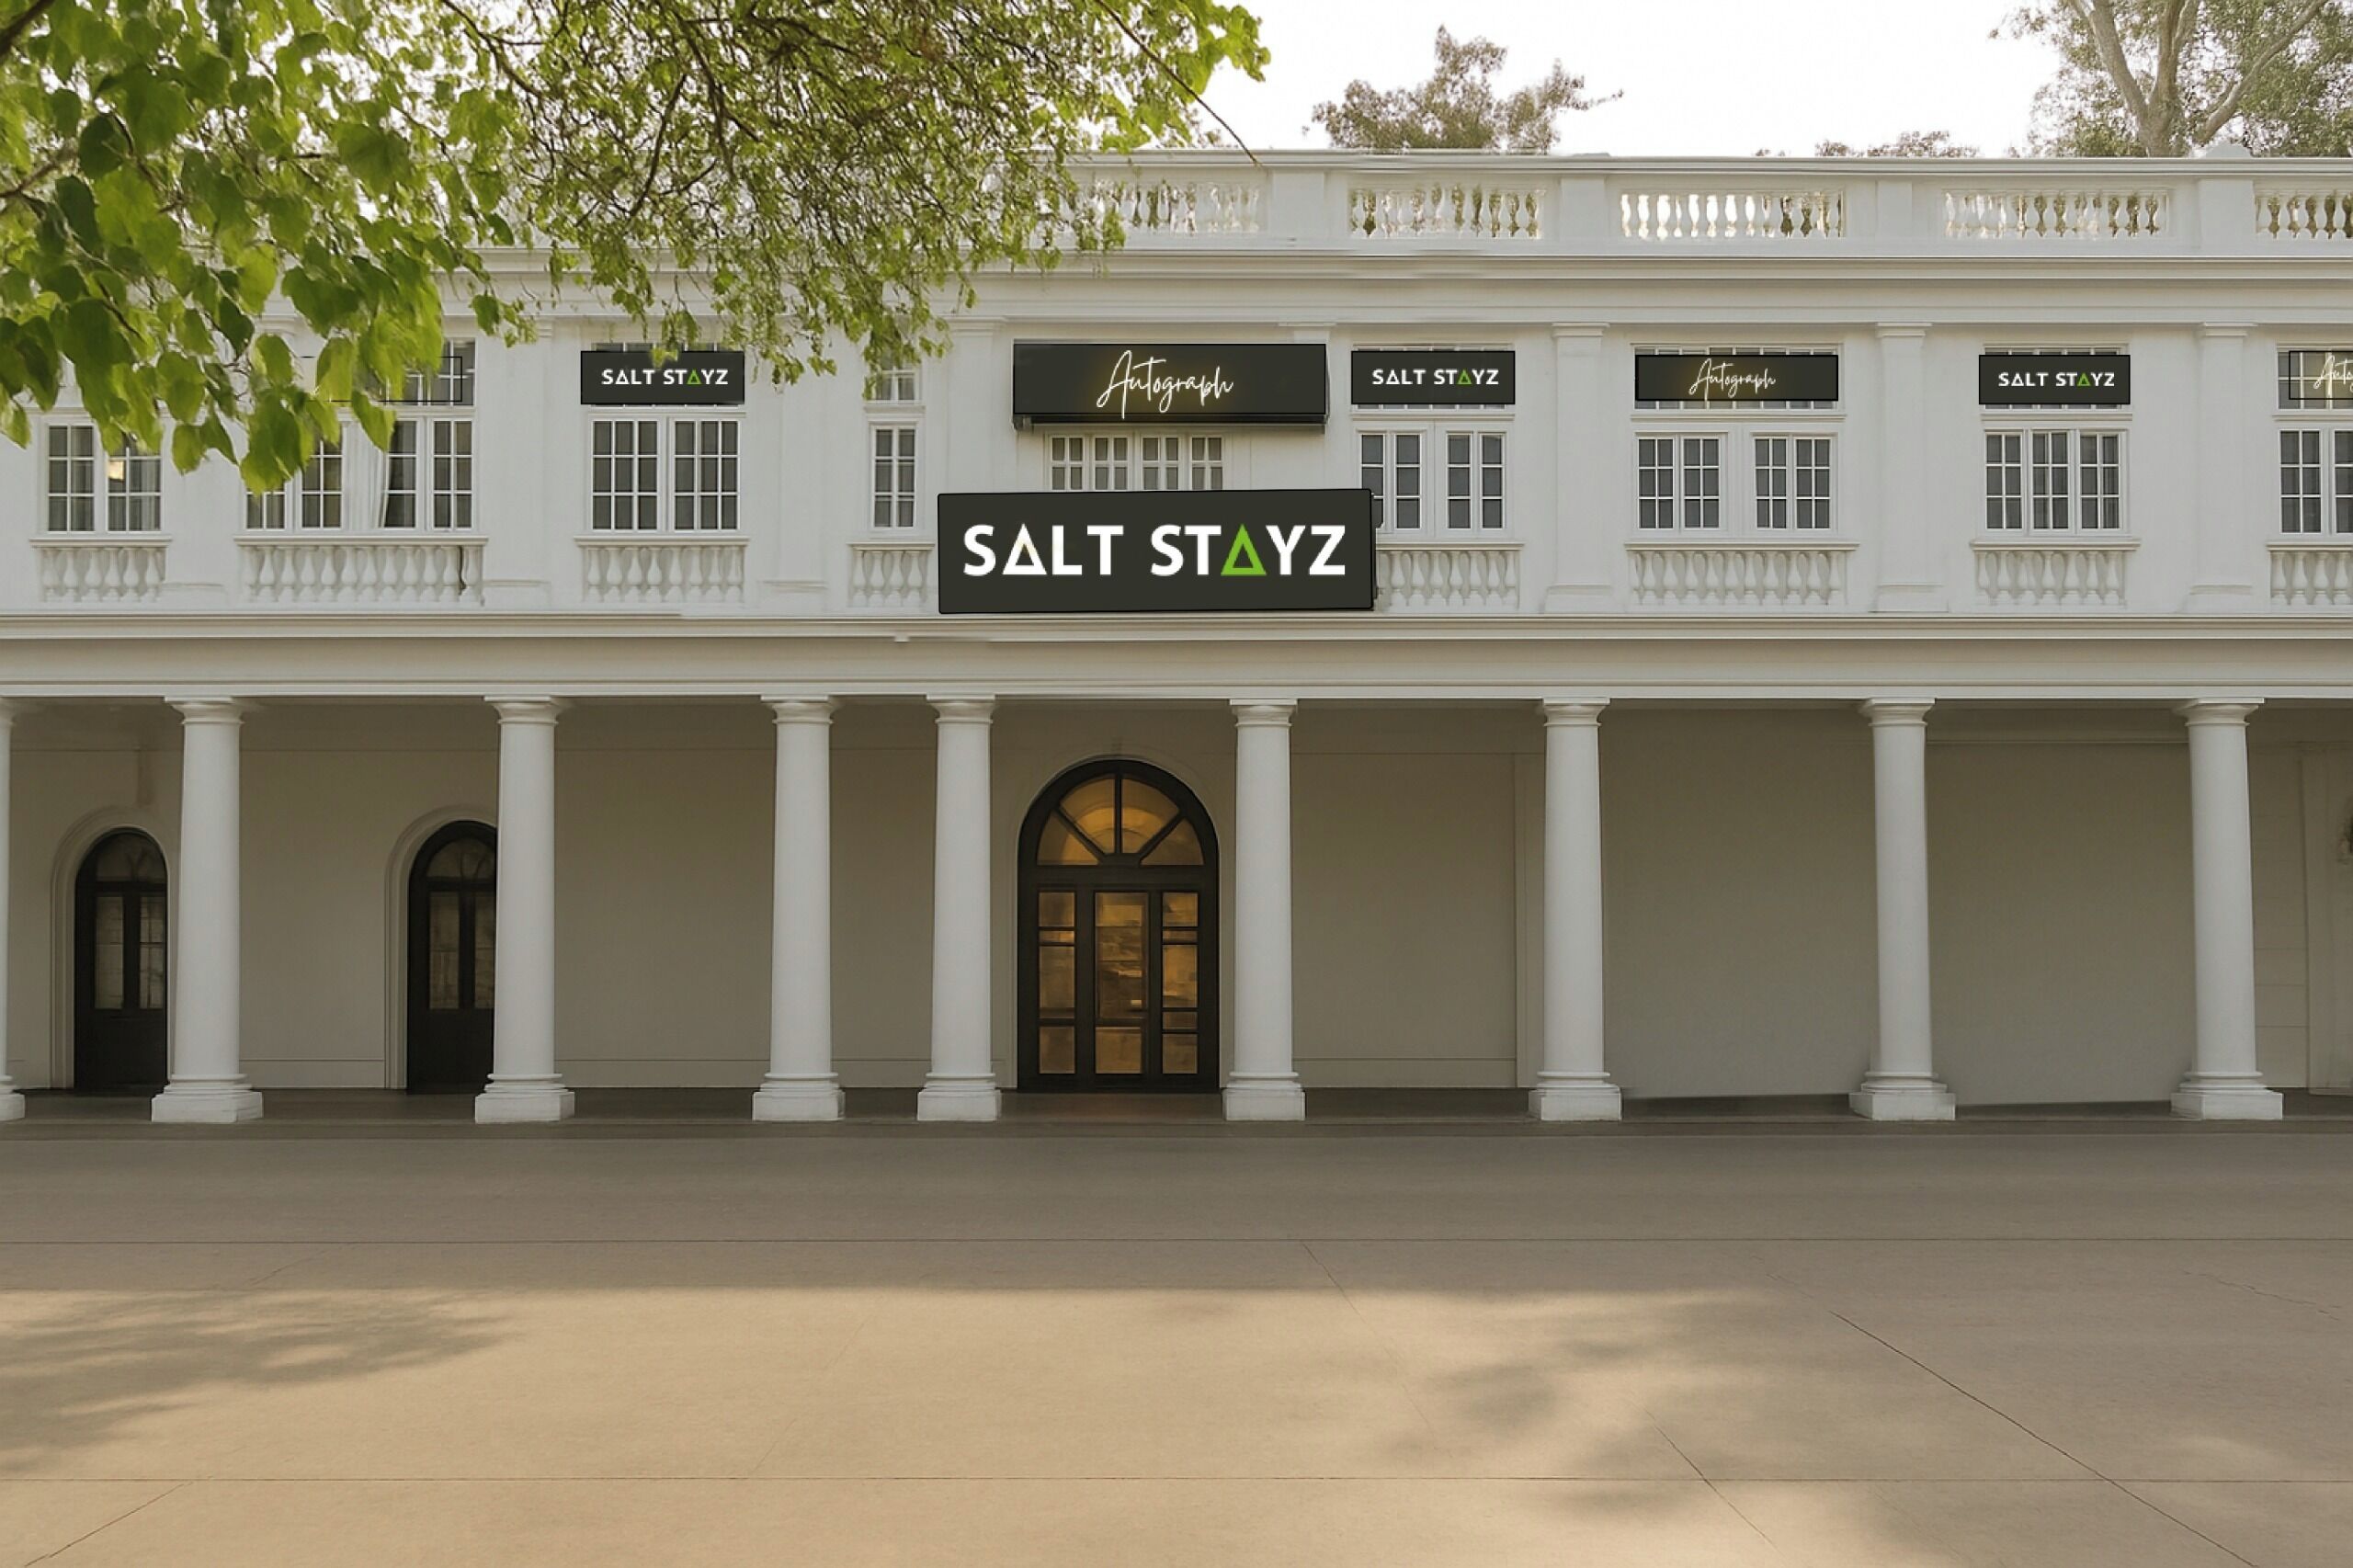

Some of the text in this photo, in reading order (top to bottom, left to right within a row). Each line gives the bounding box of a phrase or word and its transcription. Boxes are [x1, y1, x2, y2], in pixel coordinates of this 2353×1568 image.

[602, 369, 729, 385] SALT STAYZ
[1097, 350, 1233, 419] Autograph
[1372, 368, 1499, 385] SALT STAYZ
[1688, 358, 1776, 400] Autograph
[1998, 372, 2115, 387] SALT STAYZ
[963, 523, 1346, 576] SALT STAYZ
